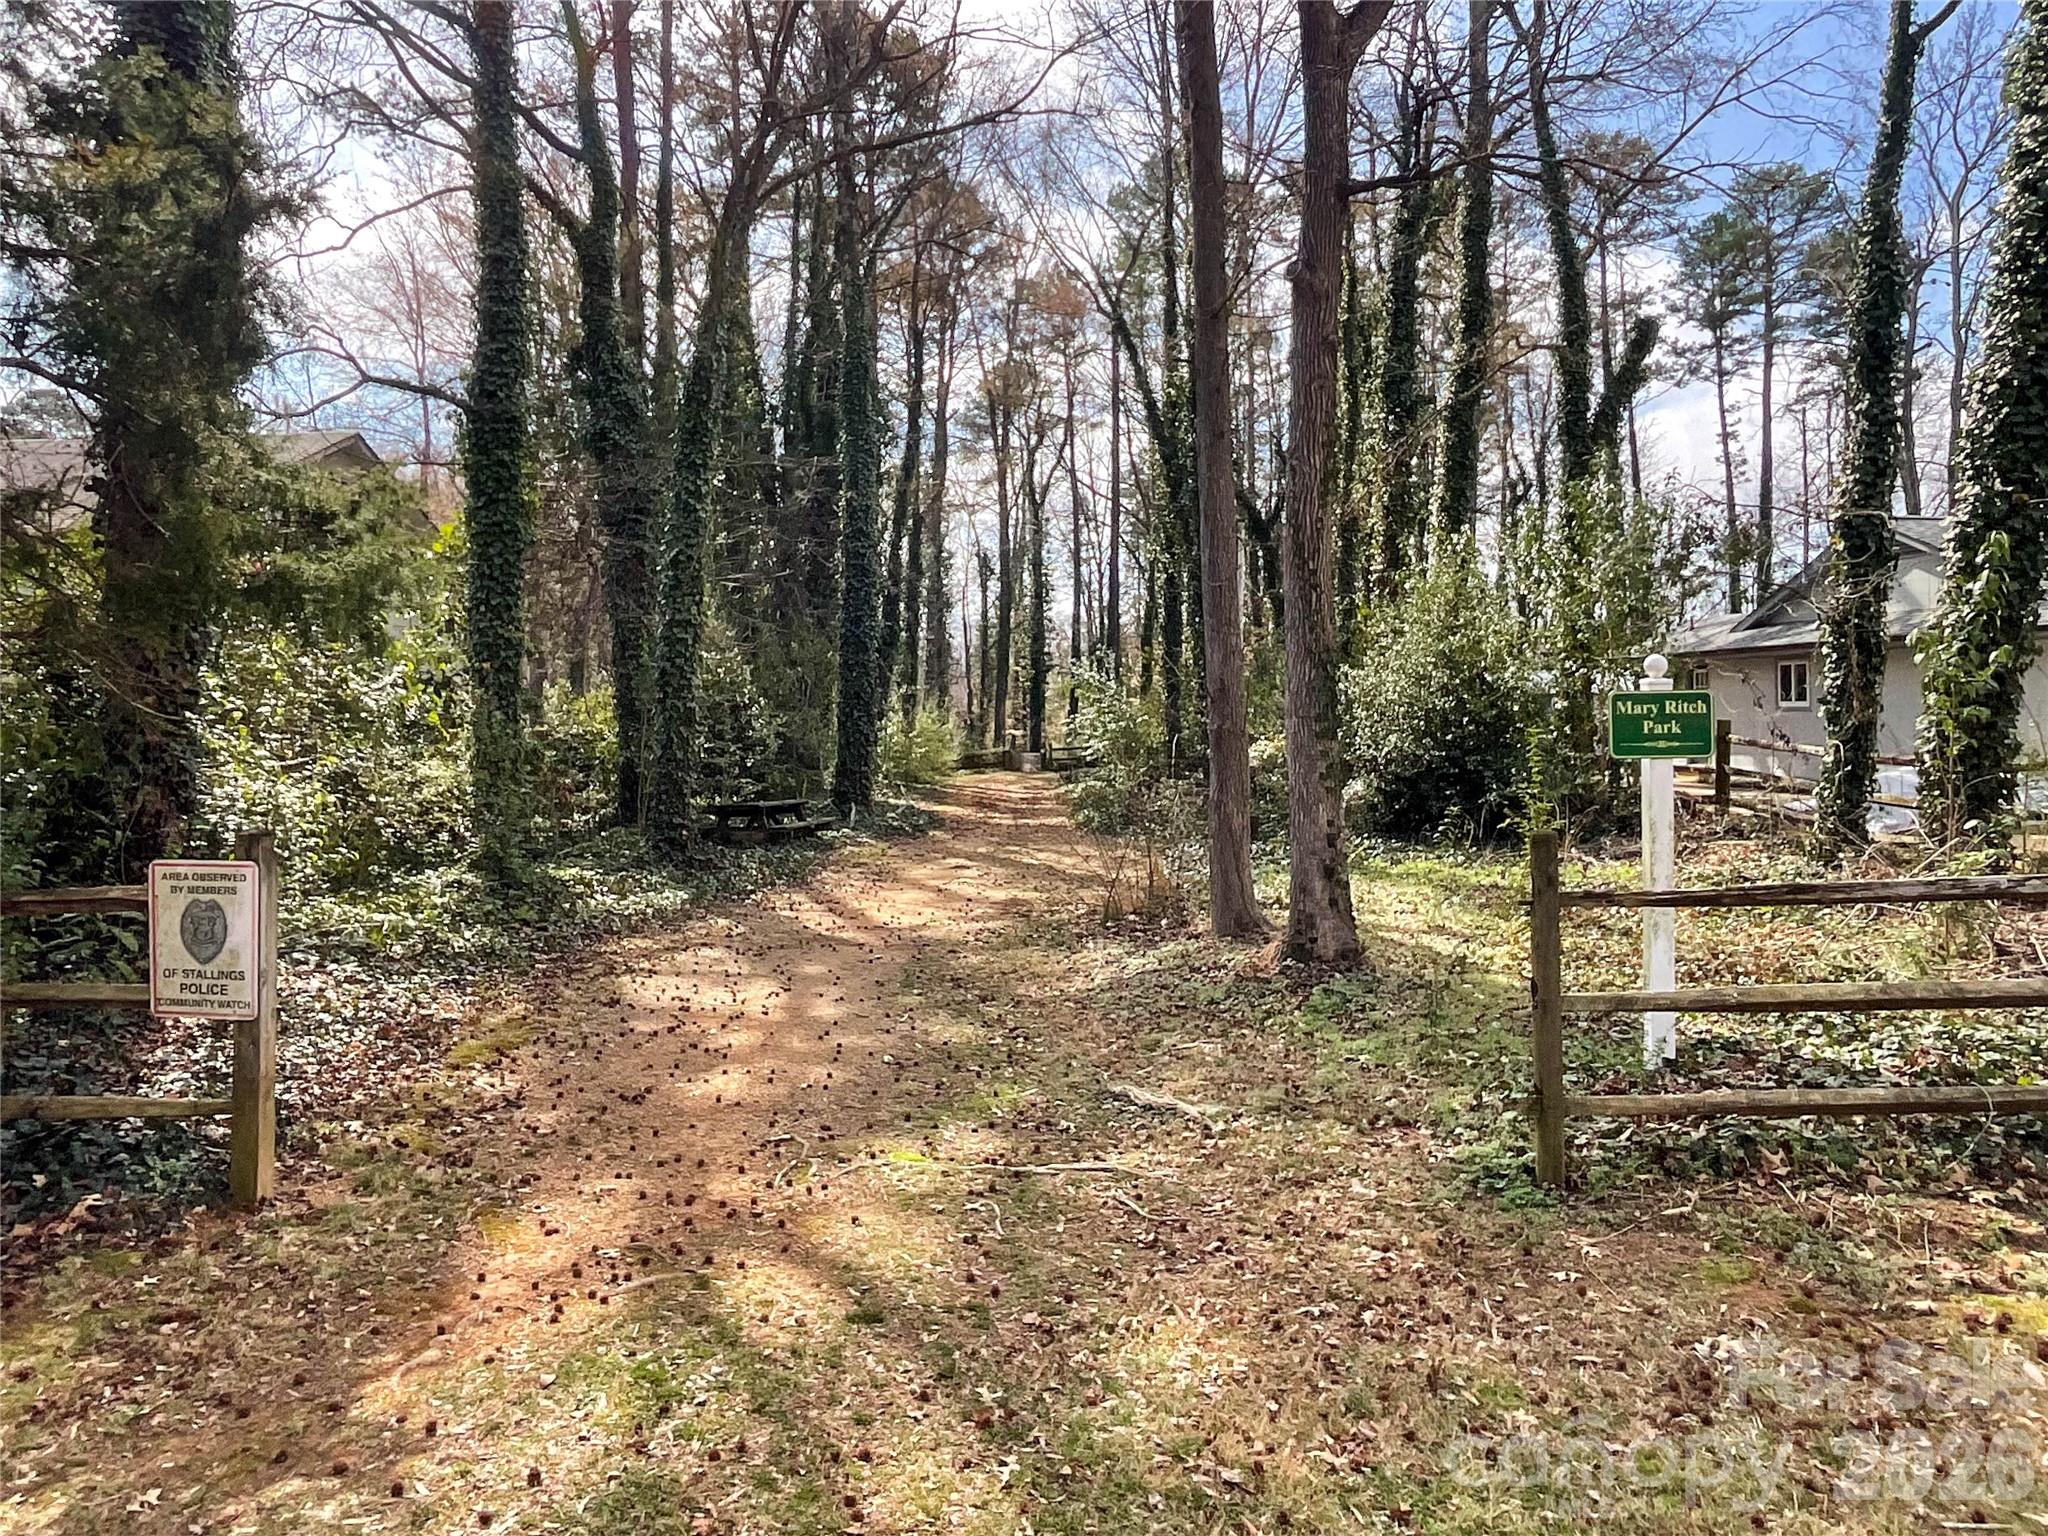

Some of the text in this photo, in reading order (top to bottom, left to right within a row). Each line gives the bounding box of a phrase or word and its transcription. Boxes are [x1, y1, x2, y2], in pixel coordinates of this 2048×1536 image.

[1616, 699, 1707, 718] Mary Ritch
[1643, 720, 1681, 734] Park
[161, 872, 247, 882] AREA OBSERVED
[170, 885, 238, 895] BY MEMBERS
[162, 968, 246, 981] OF STALLINGS
[179, 982, 229, 996] POLICE
[158, 998, 251, 1010] COMMUNITY WATCH
